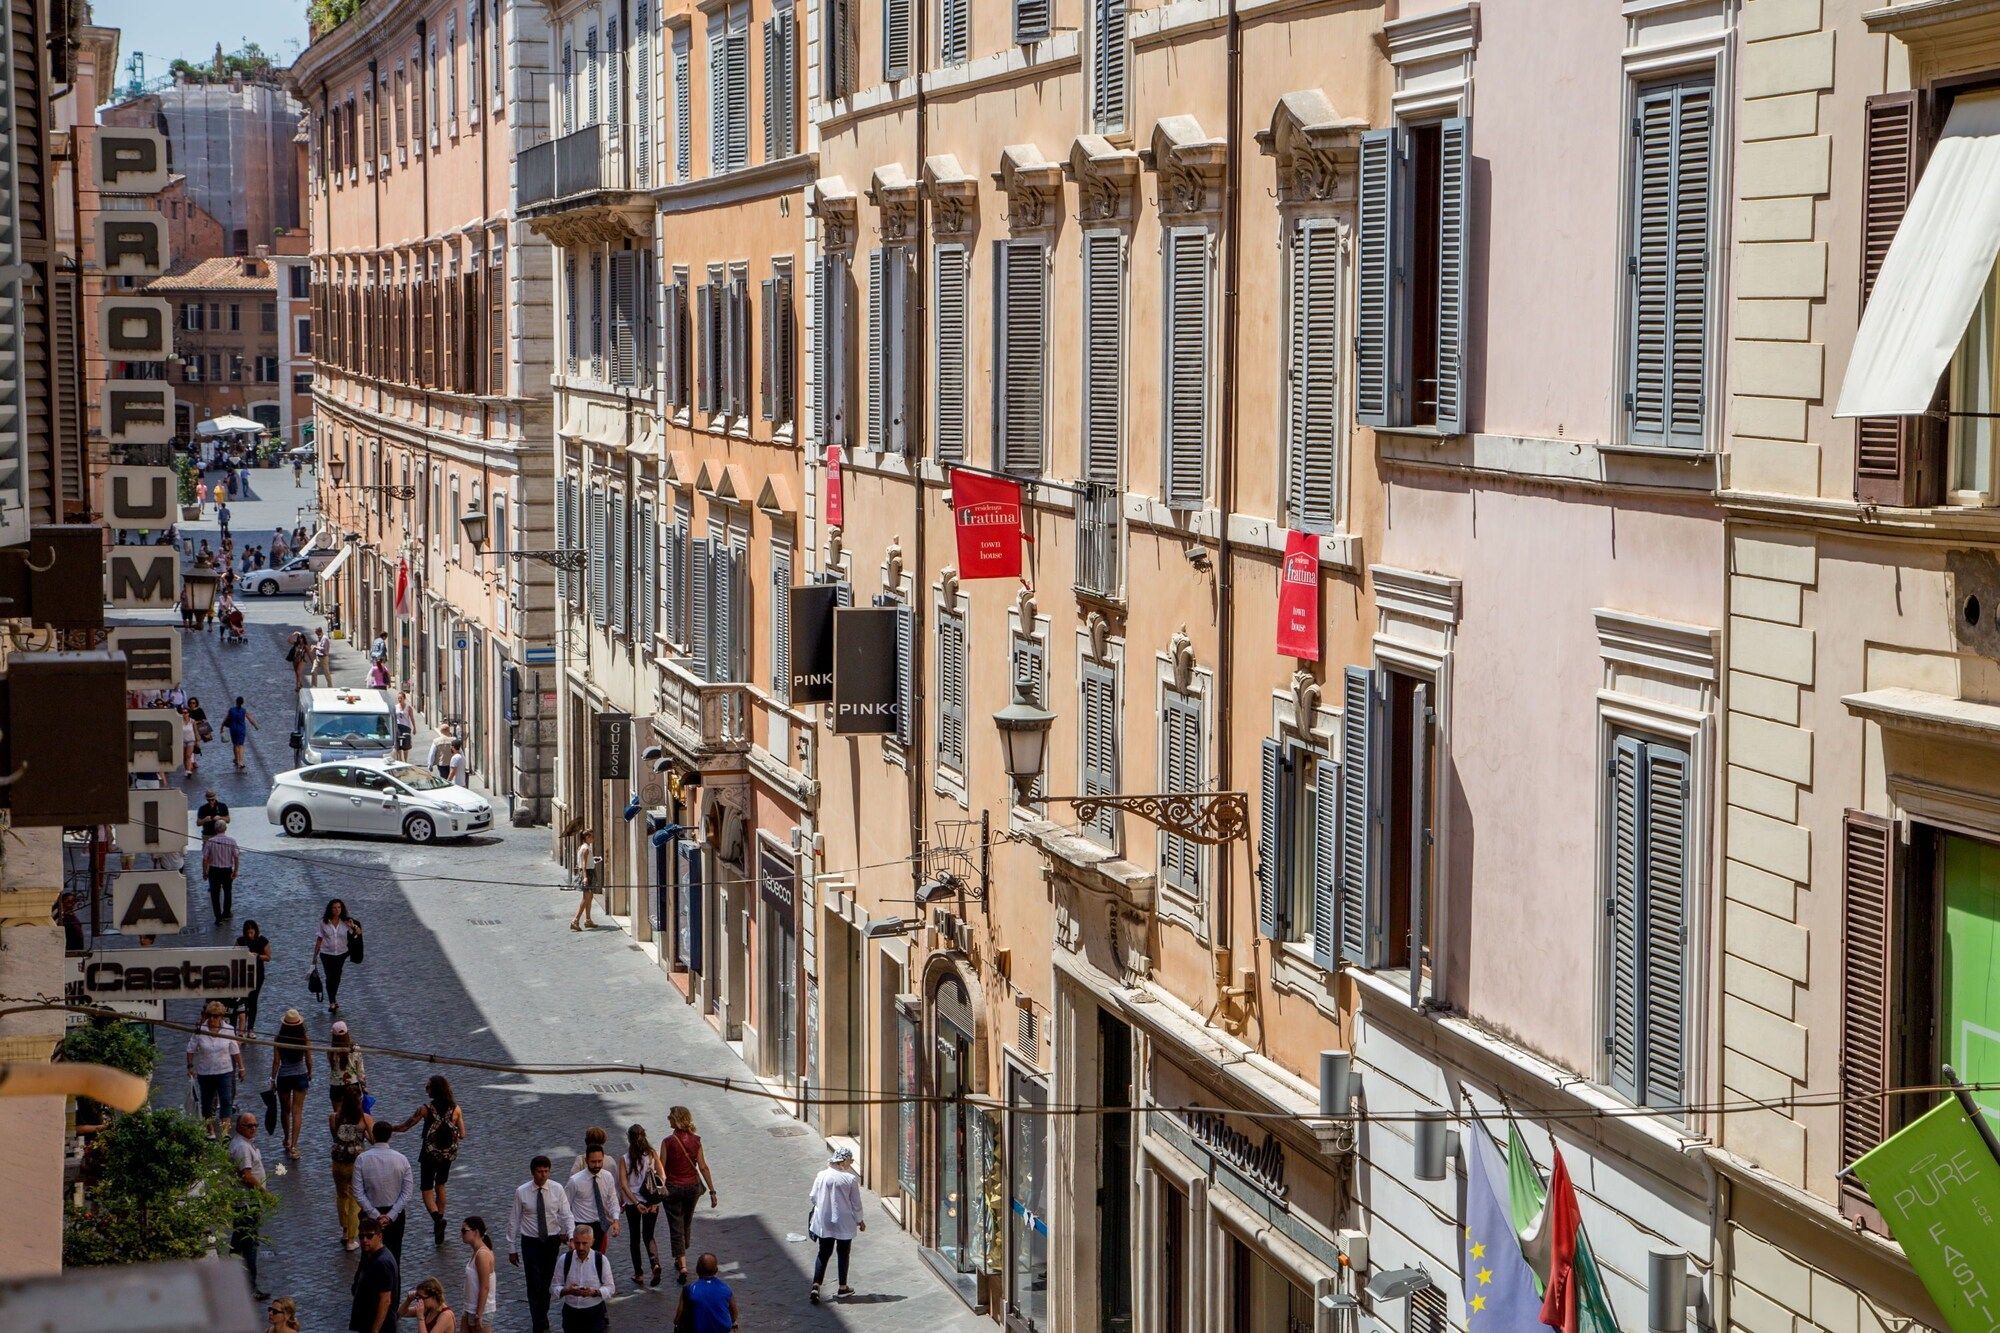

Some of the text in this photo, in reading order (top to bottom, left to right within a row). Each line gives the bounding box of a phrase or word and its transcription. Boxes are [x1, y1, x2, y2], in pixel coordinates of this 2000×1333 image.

[101, 137, 179, 926] PROFUMERIA
[963, 508, 1017, 527] frattina
[980, 550, 1003, 560] house
[981, 541, 1001, 549] town
[1287, 559, 1316, 584] frattina
[1291, 619, 1306, 632] house
[1292, 606, 1305, 617] town
[794, 672, 834, 687] PINK
[610, 722, 621, 777] GUESS
[762, 868, 792, 906] Rebecca
[86, 958, 256, 992] Castelli
[1893, 1149, 1980, 1221] PURE
[1971, 1196, 1994, 1227] FOR
[1928, 1221, 2000, 1333] FASHI
